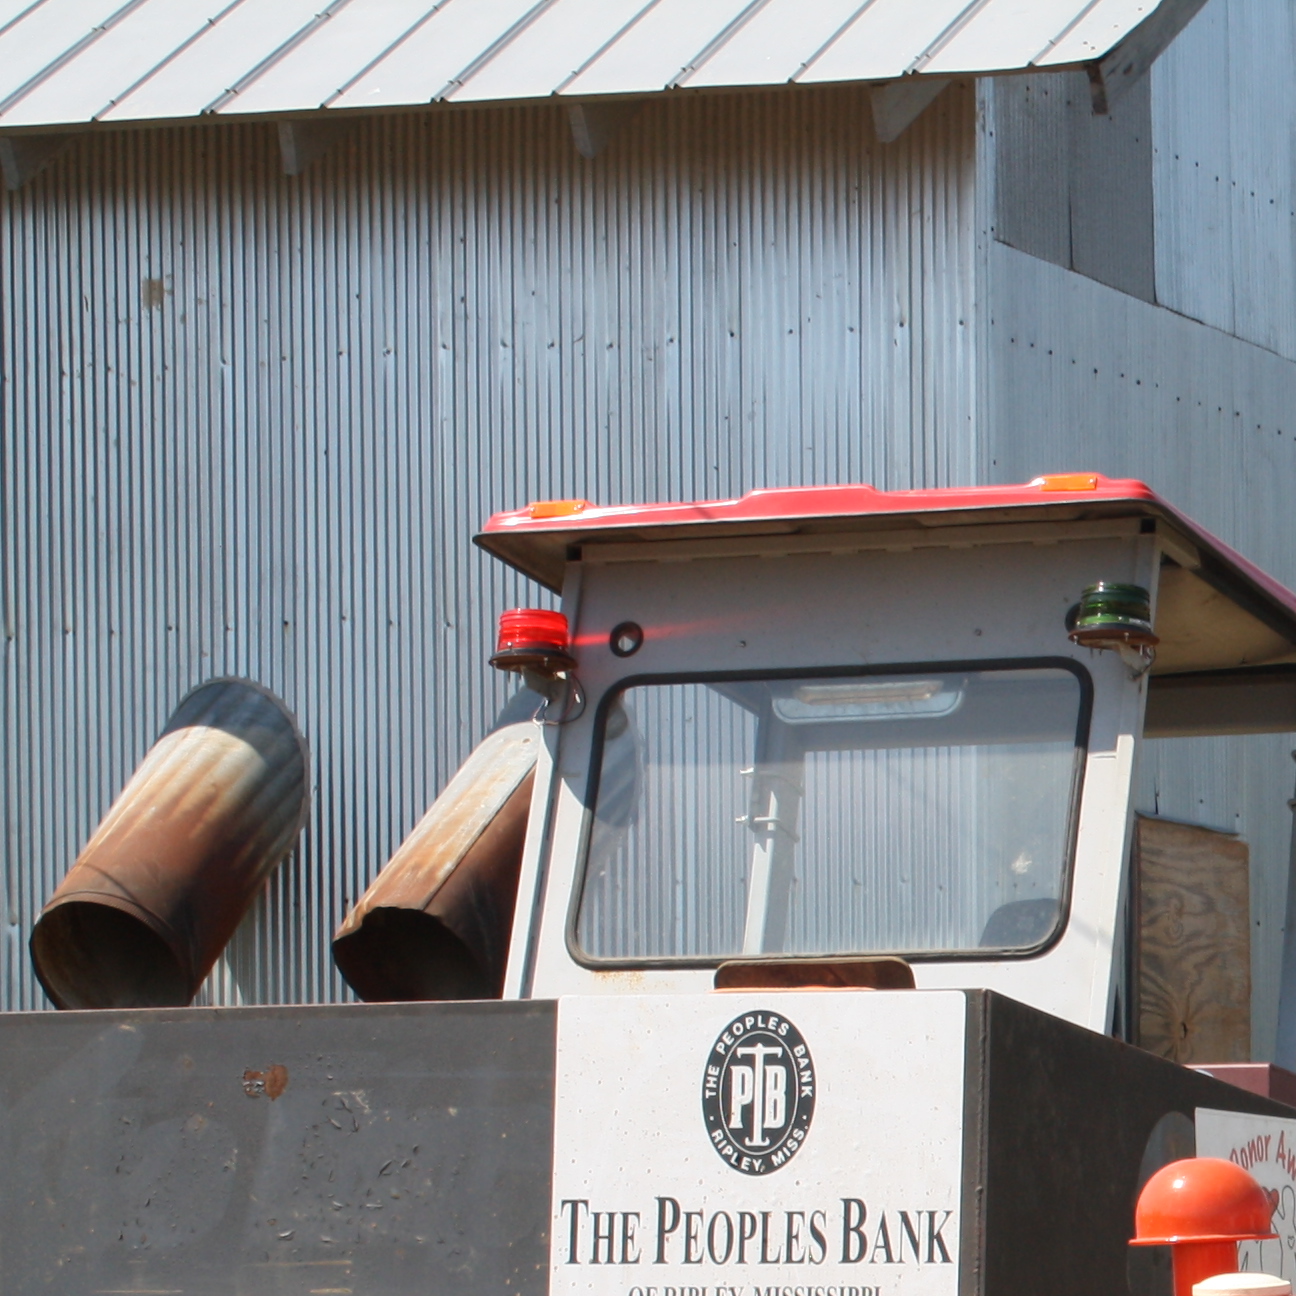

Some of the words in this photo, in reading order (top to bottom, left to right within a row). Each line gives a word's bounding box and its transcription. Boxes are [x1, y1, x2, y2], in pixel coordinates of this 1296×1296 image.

[706, 1065, 720, 1098] THE
[716, 1015, 789, 1055] PEOPLES
[793, 1043, 813, 1098] BANK
[560, 1198, 642, 1265] THE
[652, 1196, 828, 1265] PEOPLES
[838, 1197, 955, 1264] BANK
